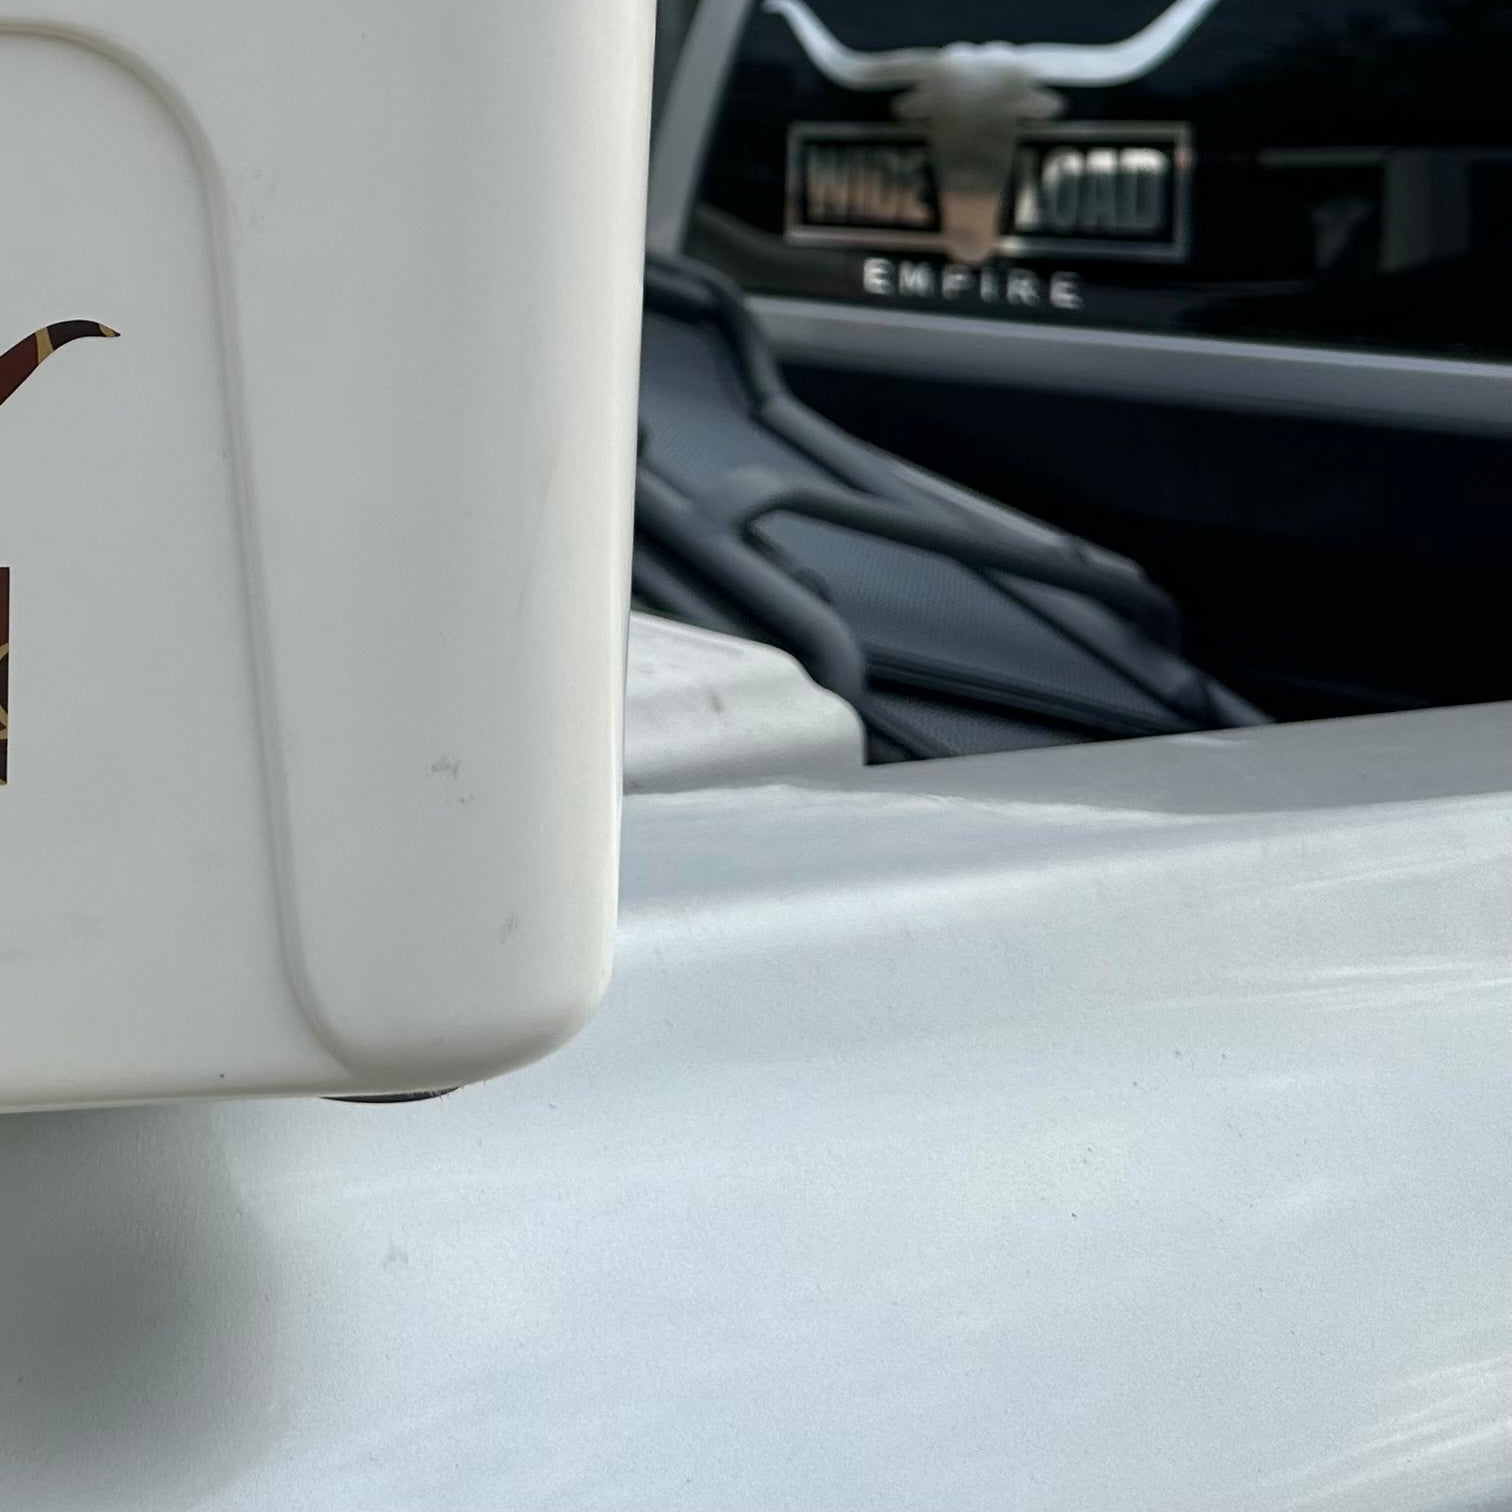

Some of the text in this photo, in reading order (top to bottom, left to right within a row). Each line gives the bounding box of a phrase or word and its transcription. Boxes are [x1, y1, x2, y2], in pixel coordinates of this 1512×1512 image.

[806, 144, 1168, 231] WIDE LOAD
[863, 257, 1084, 309] EMPIRE
